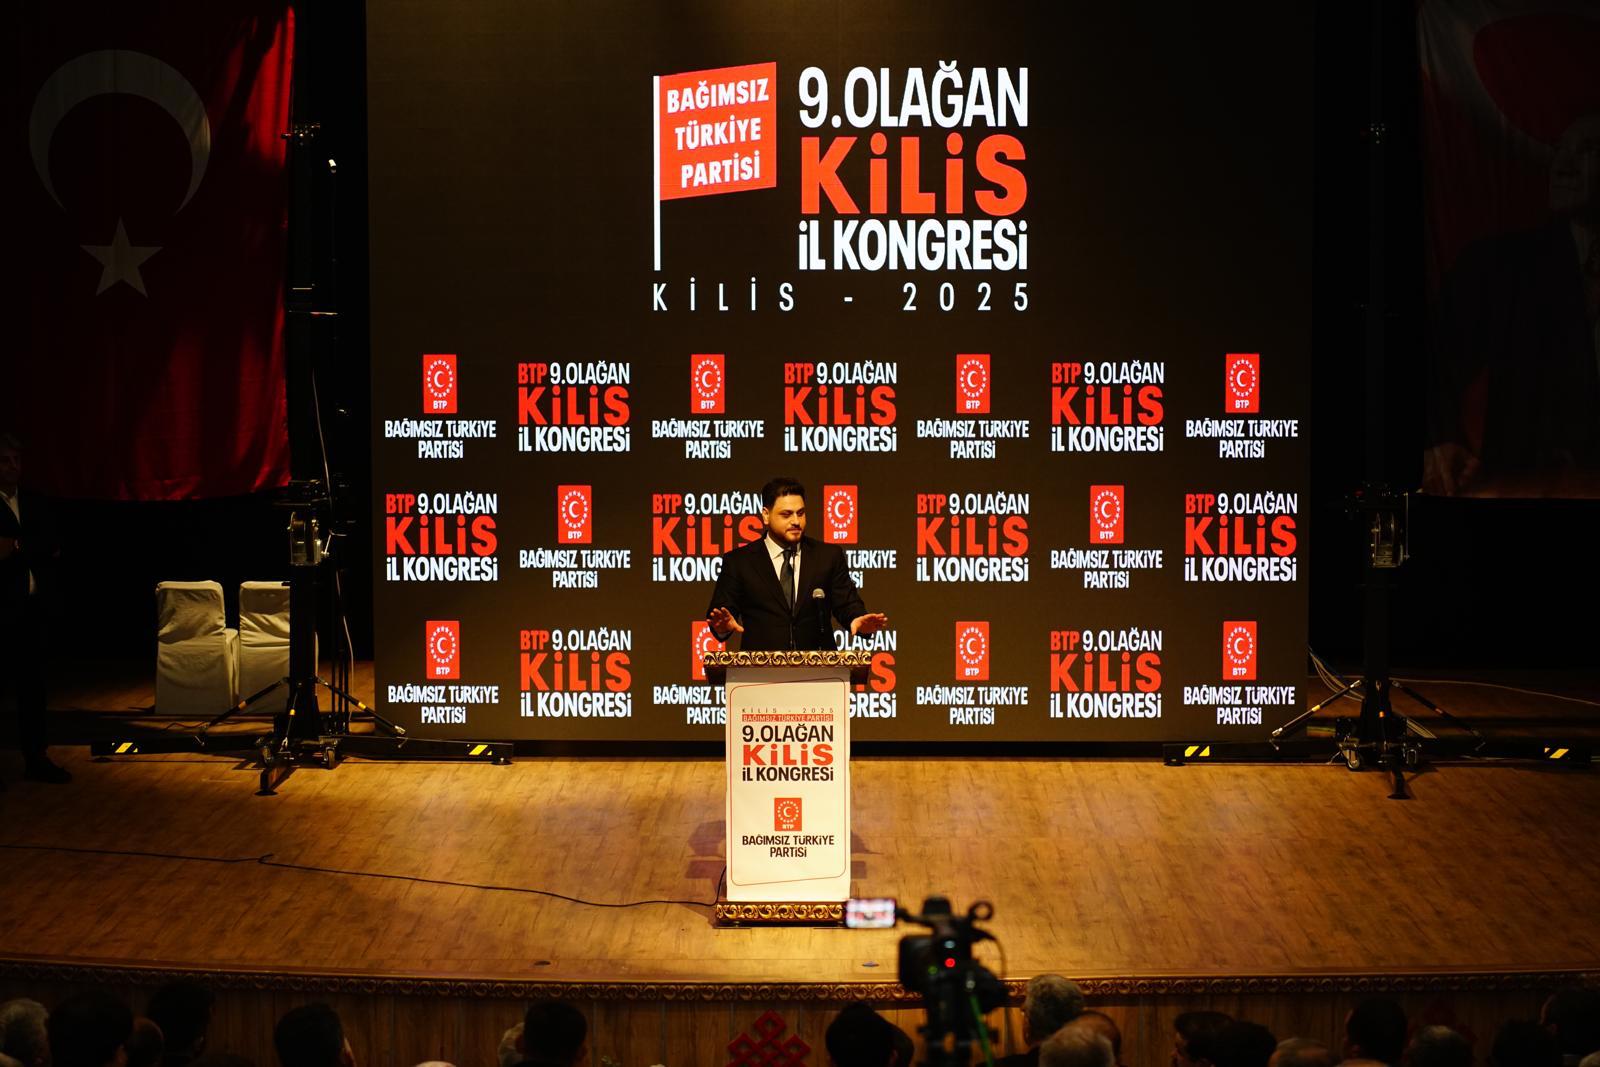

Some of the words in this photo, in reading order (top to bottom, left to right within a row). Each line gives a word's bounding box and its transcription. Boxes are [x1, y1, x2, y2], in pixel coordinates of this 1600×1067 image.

[666, 78, 769, 113] BAĞIMSIZ
[903, 283, 1027, 311] 2025
[518, 363, 547, 384] BTP
[785, 363, 814, 384] BTP
[1052, 363, 1081, 384] BTP
[433, 400, 447, 409] BTP
[701, 400, 715, 409] BTP
[966, 400, 980, 409] BTP
[1235, 400, 1249, 408] BTP
[385, 418, 443, 437] BAĞIMSIZ
[652, 418, 710, 437] BAĞIMSIZ
[917, 418, 975, 437] BAĞIMSIZ
[1186, 418, 1244, 437] BAĞIMSIZ
[386, 494, 415, 513] BTP
[653, 494, 682, 514] BTP
[917, 494, 946, 514] BTP
[1186, 494, 1215, 513] BTP
[568, 531, 582, 539] BTP
[834, 531, 847, 539] BTP
[1100, 531, 1114, 539] BTP
[520, 548, 578, 568] BAĞIMSIZ
[1051, 548, 1109, 568] BAĞIMSIZ
[670, 557, 722, 581] KONG
[520, 630, 549, 650] BTP
[1051, 631, 1080, 651] BTP
[965, 668, 979, 676] BTP
[388, 684, 446, 703] BAĞIMSIZ
[917, 685, 974, 705] BAĞIMSIZ
[1184, 685, 1242, 704] BAĞIMSIZ
